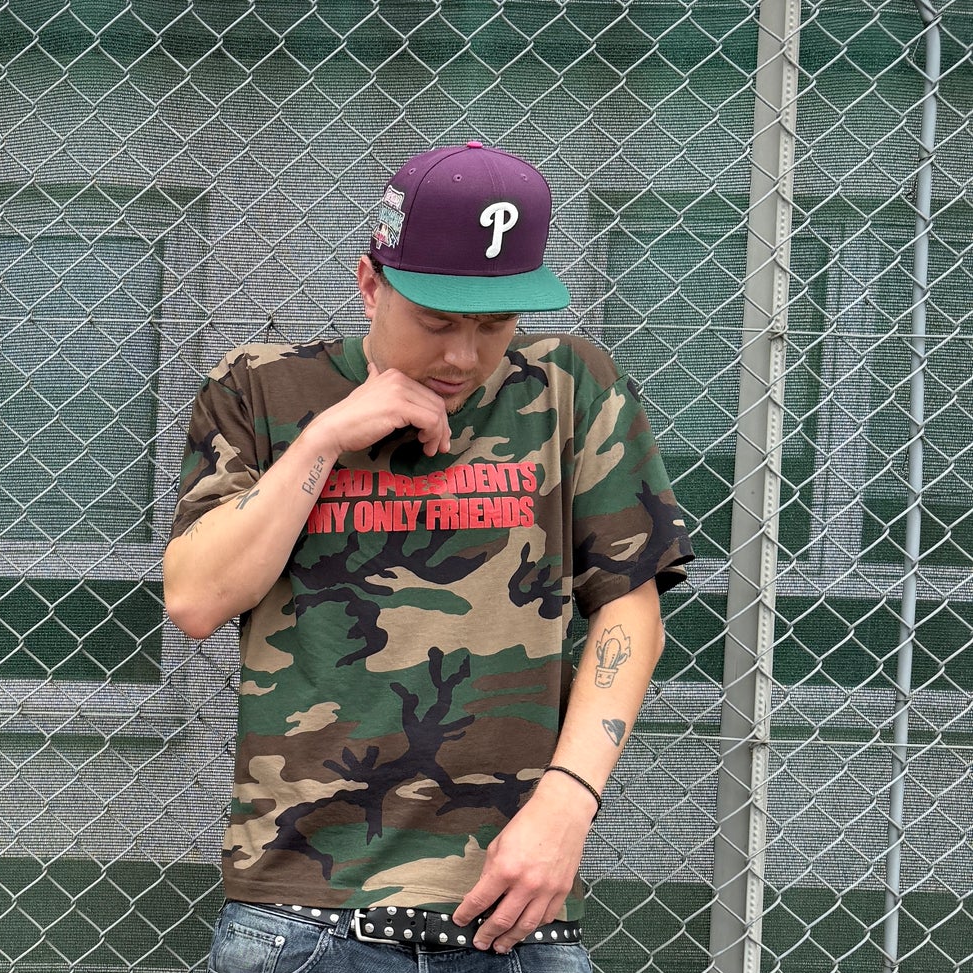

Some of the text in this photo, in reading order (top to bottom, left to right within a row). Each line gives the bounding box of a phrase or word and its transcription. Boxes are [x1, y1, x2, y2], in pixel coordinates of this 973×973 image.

[480, 201, 519, 259] P
[320, 461, 538, 498] EAD PRESIDENTS
[307, 496, 535, 534] MY ONLY FRIENDS
